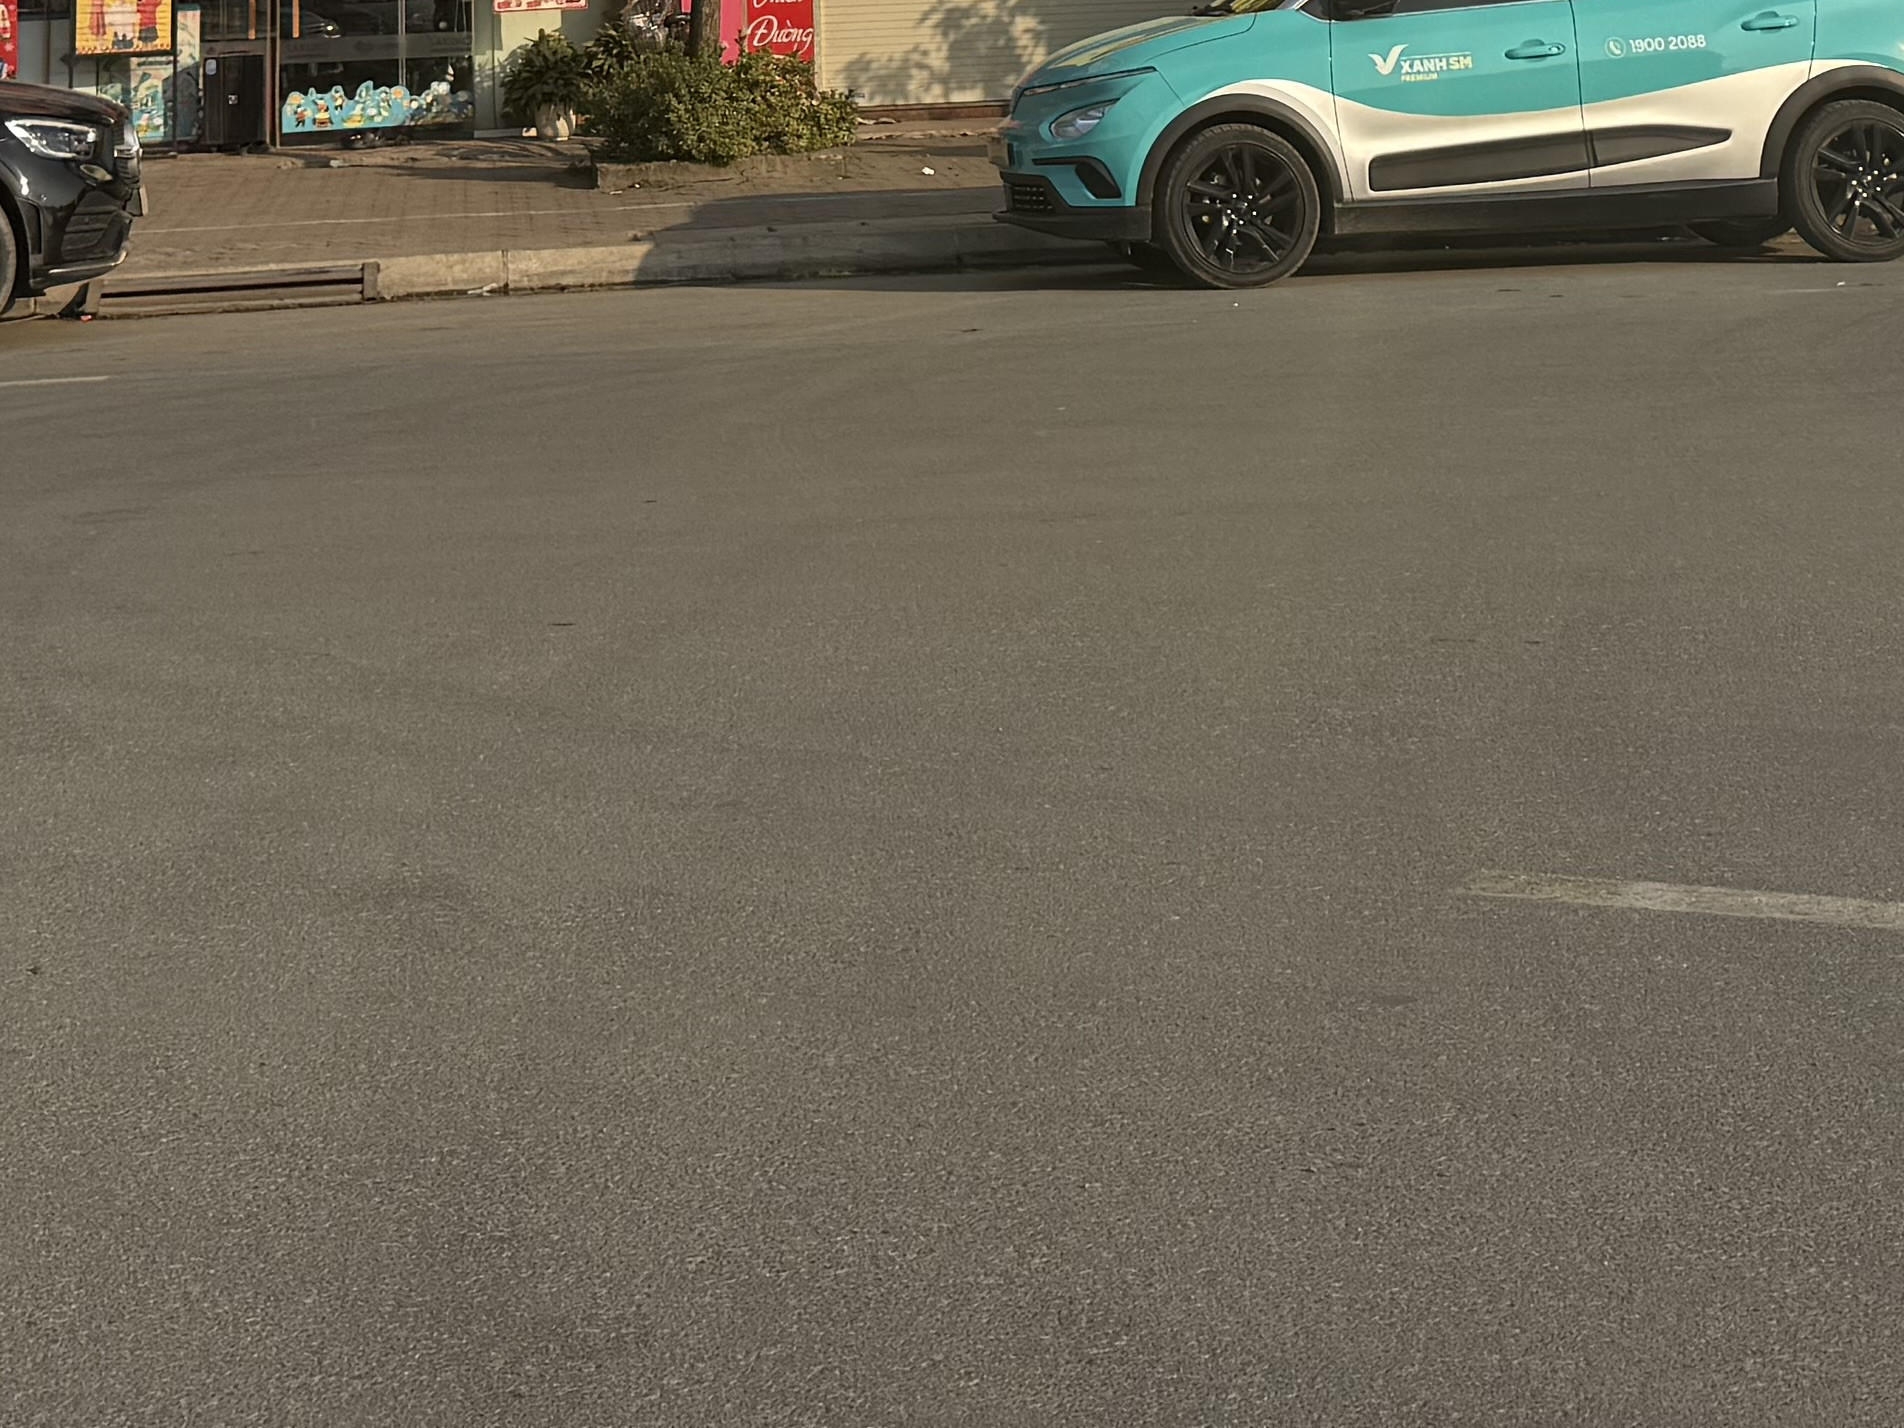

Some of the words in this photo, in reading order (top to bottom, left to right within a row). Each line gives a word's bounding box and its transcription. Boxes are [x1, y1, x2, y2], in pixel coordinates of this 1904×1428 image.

[1629, 36, 1666, 53] 1900
[1668, 34, 1707, 50] 2088
[1400, 58, 1447, 74] XANH
[1448, 55, 1473, 70] SM
